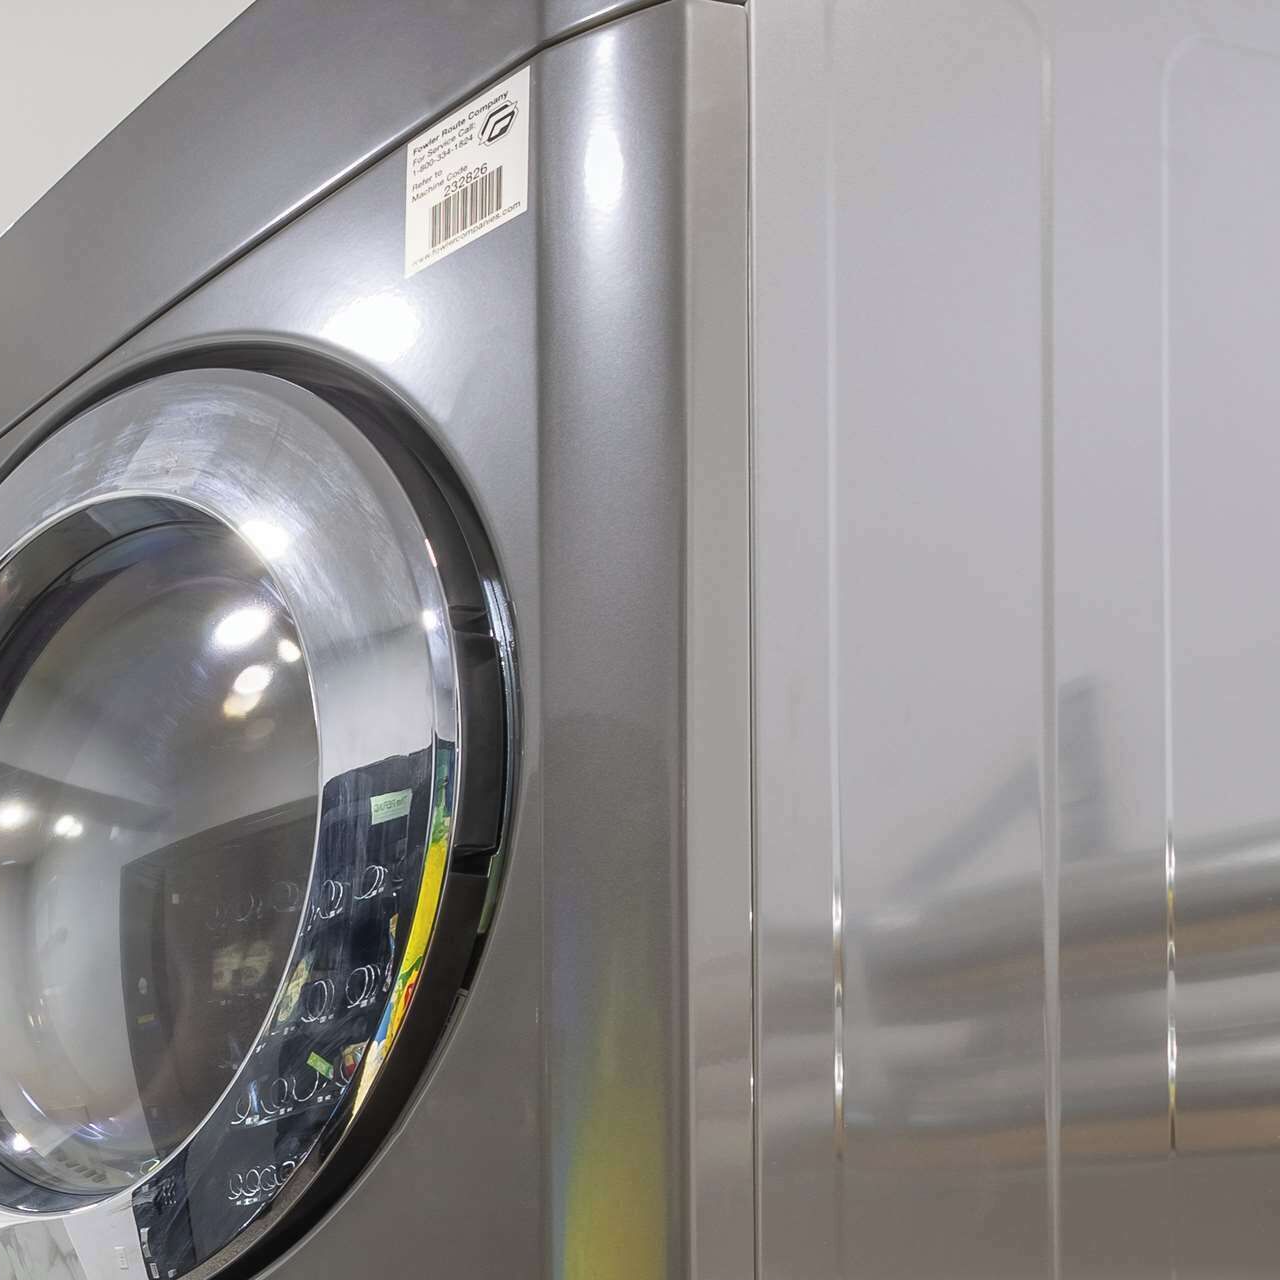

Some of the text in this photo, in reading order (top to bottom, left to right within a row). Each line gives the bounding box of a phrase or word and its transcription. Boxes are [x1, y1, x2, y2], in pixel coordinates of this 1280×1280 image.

[413, 91, 509, 156] Fowler Route Company
[413, 155, 425, 167] For
[427, 135, 456, 157] Service
[412, 170, 443, 192] Refer to
[412, 165, 468, 203] Machine Code
[443, 162, 488, 197] 232826
